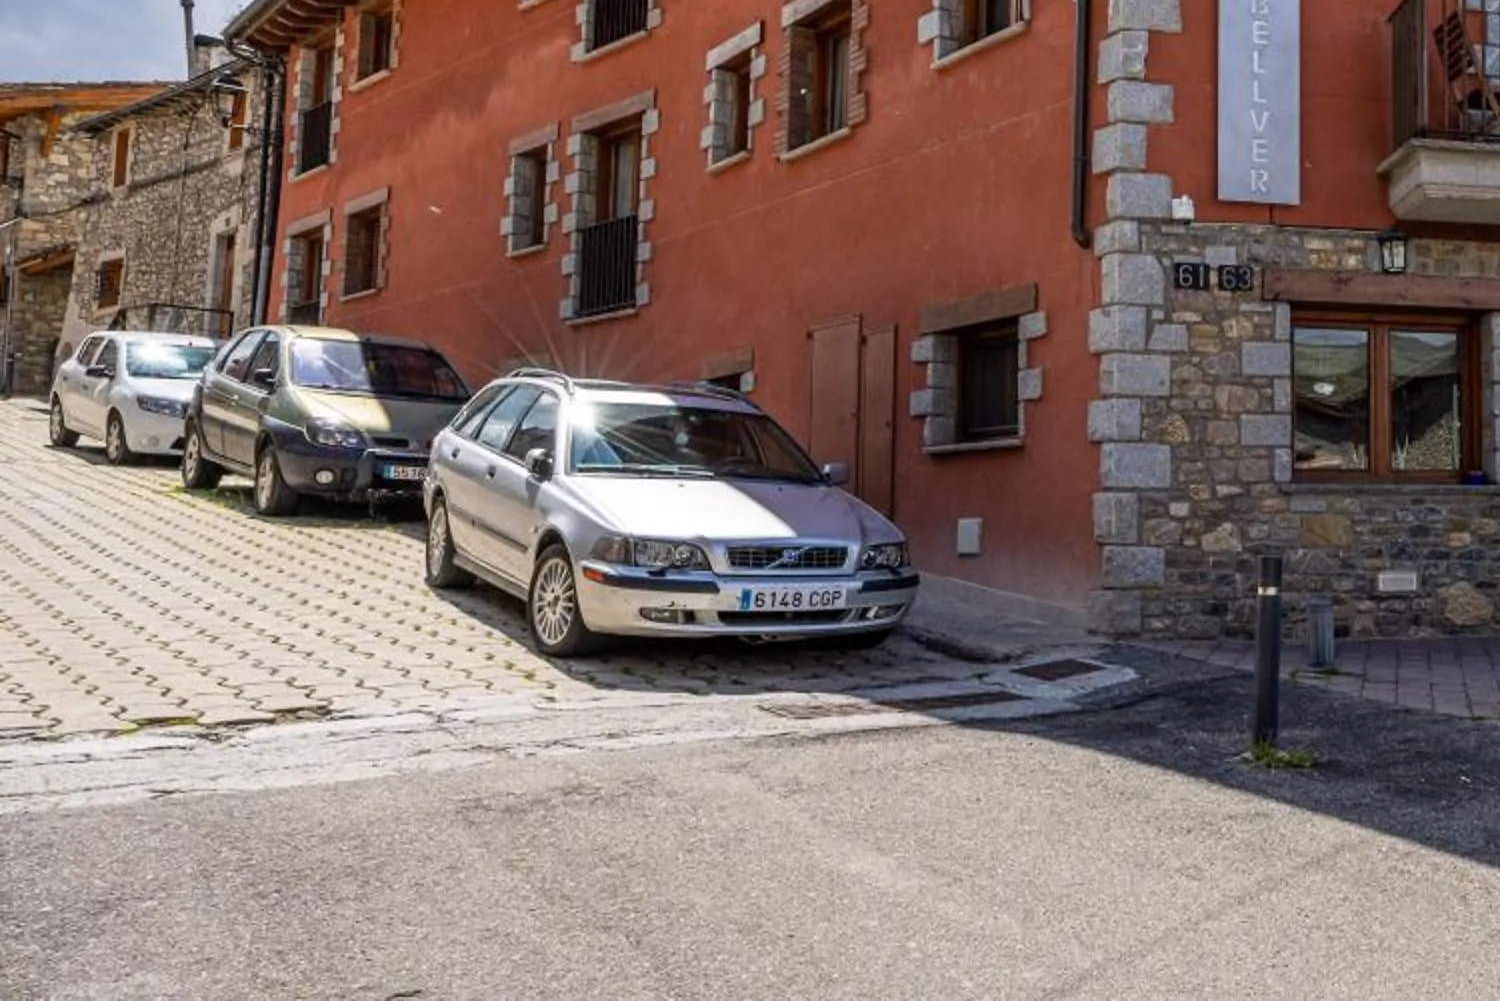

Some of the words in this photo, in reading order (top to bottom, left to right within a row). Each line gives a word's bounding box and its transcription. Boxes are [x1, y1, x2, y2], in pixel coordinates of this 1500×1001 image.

[1179, 264, 1206, 288] 61
[1223, 266, 1252, 290] 63
[754, 591, 803, 608] 6148
[808, 590, 843, 606] CGP
